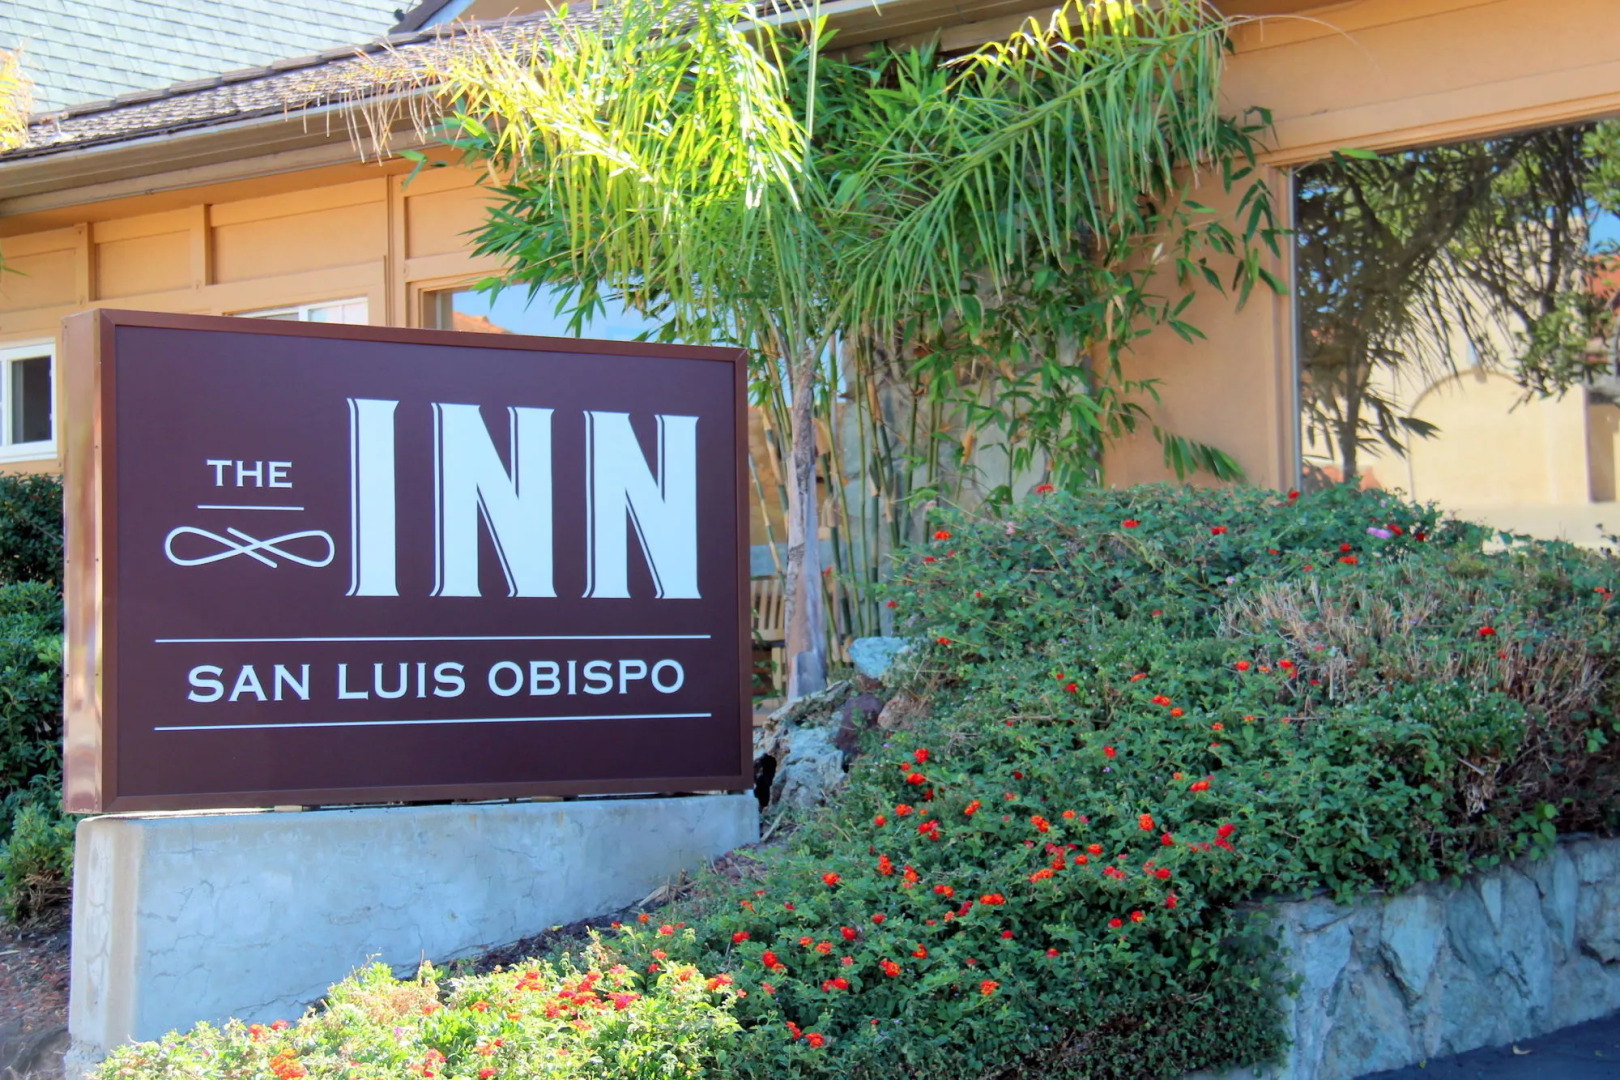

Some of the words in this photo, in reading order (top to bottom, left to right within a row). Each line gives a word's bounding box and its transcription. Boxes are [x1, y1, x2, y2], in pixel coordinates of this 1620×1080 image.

[206, 459, 294, 489] THE
[345, 397, 702, 600] INN
[187, 664, 311, 703] SAN
[337, 661, 467, 700] LUIS
[487, 659, 685, 697] OBISPO
